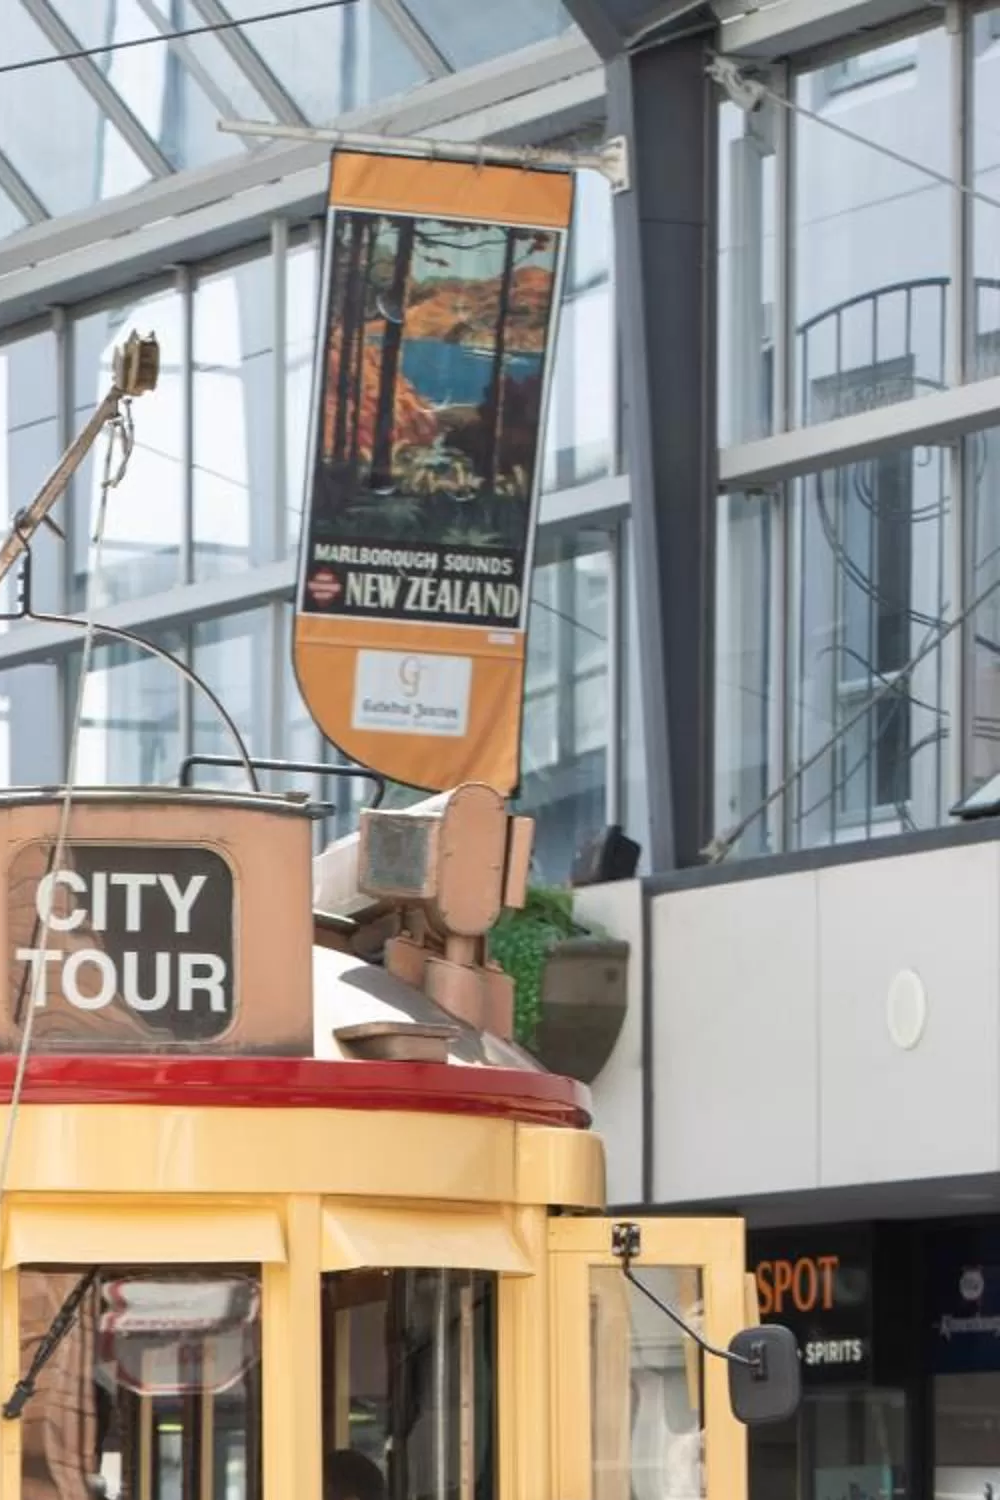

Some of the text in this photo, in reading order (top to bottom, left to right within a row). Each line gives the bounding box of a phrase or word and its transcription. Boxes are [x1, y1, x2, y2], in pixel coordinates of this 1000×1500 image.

[314, 544, 513, 575] MARLBOROUGH SOUNDS
[346, 572, 401, 608] NEW
[404, 577, 520, 617] ZEALAND
[36, 869, 208, 933] CITY
[15, 948, 227, 1013] TOUR
[756, 1255, 839, 1316] SPOT
[806, 1339, 862, 1365] SPIRITS
